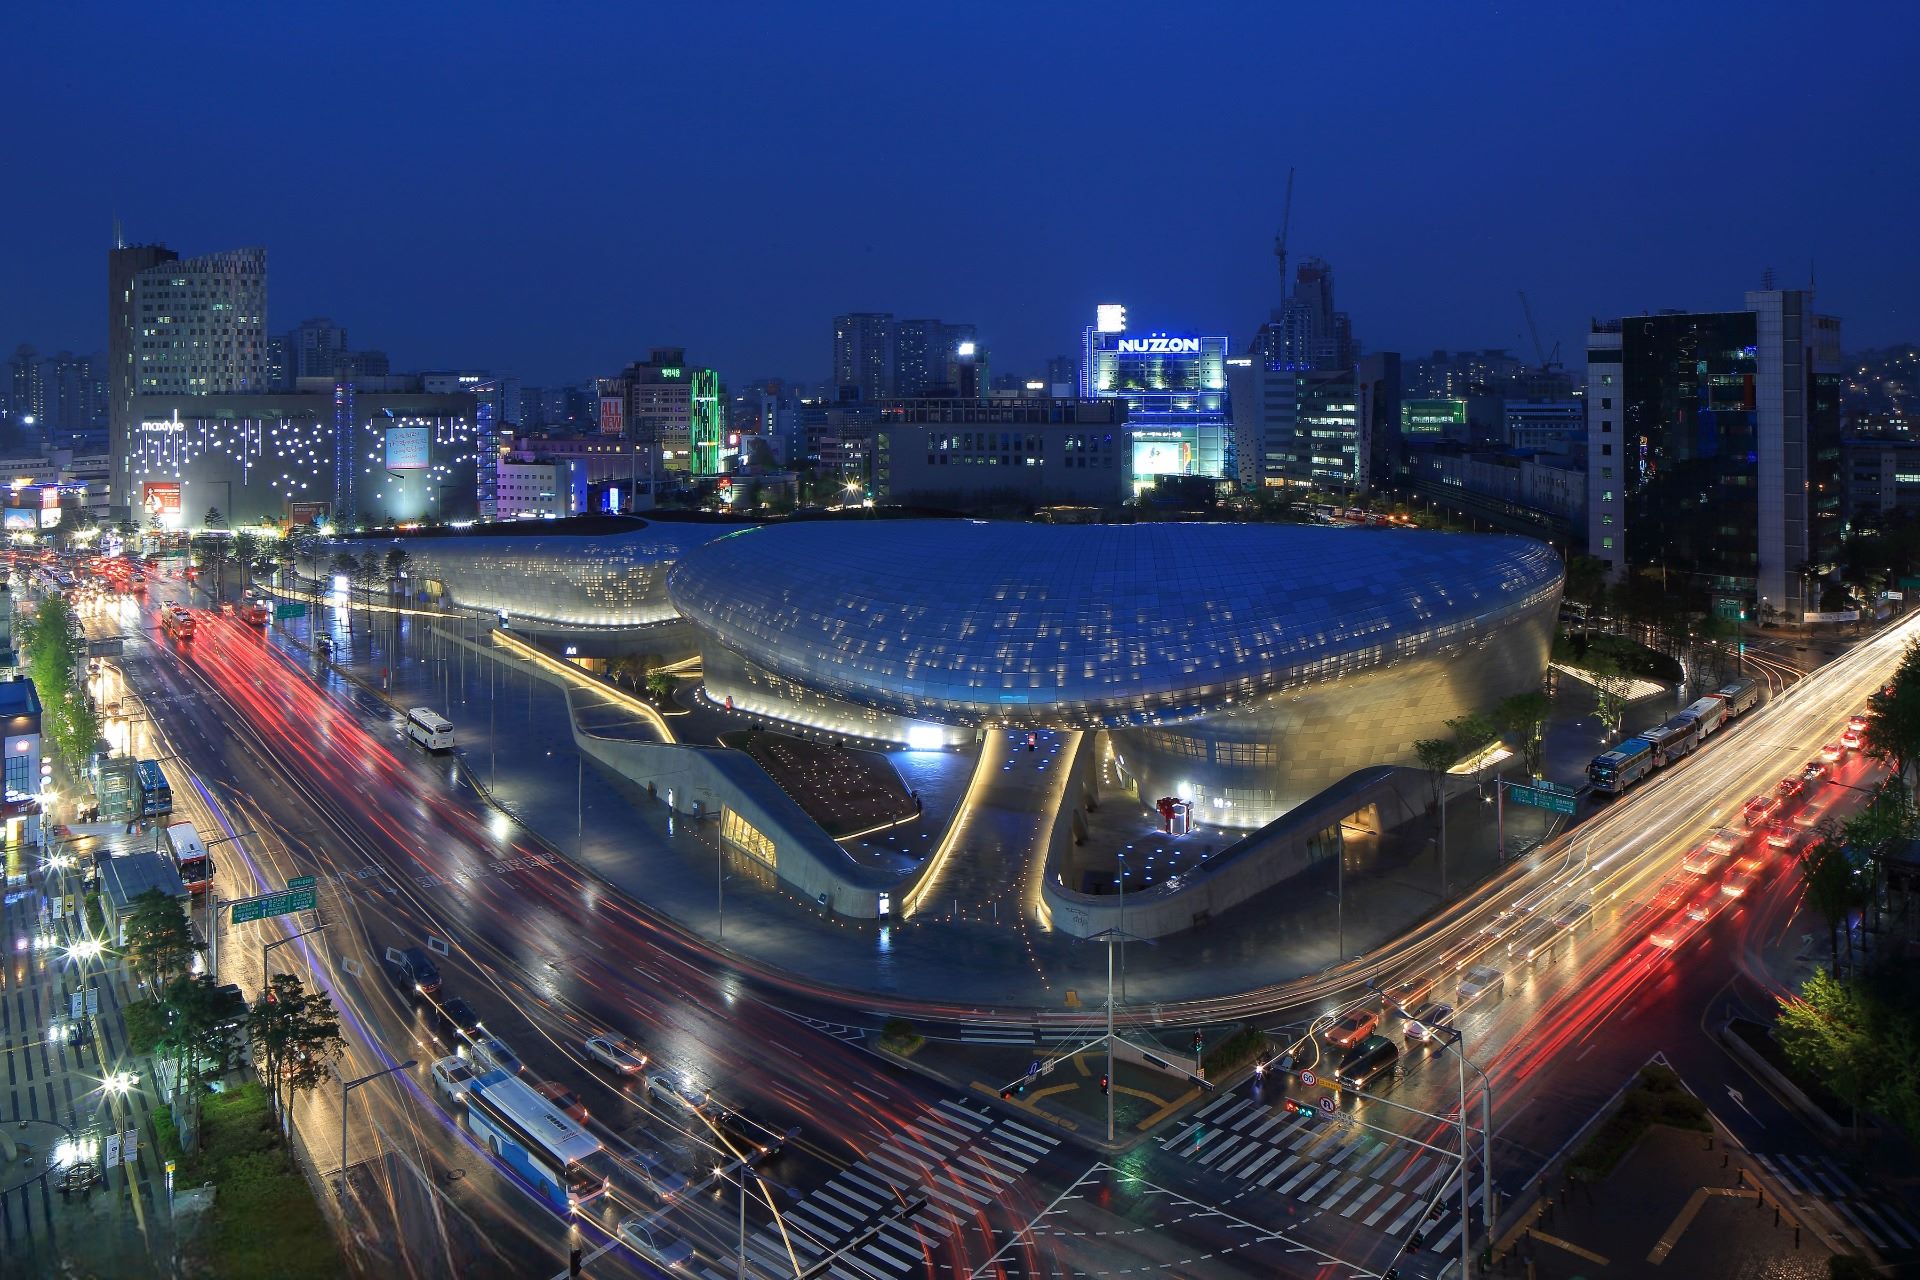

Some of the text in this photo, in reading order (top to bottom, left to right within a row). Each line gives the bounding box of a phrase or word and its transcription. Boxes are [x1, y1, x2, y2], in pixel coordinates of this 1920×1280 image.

[602, 401, 621, 417] ALL
[602, 416, 621, 428] NEW
[1303, 1072, 1313, 1083] 60
